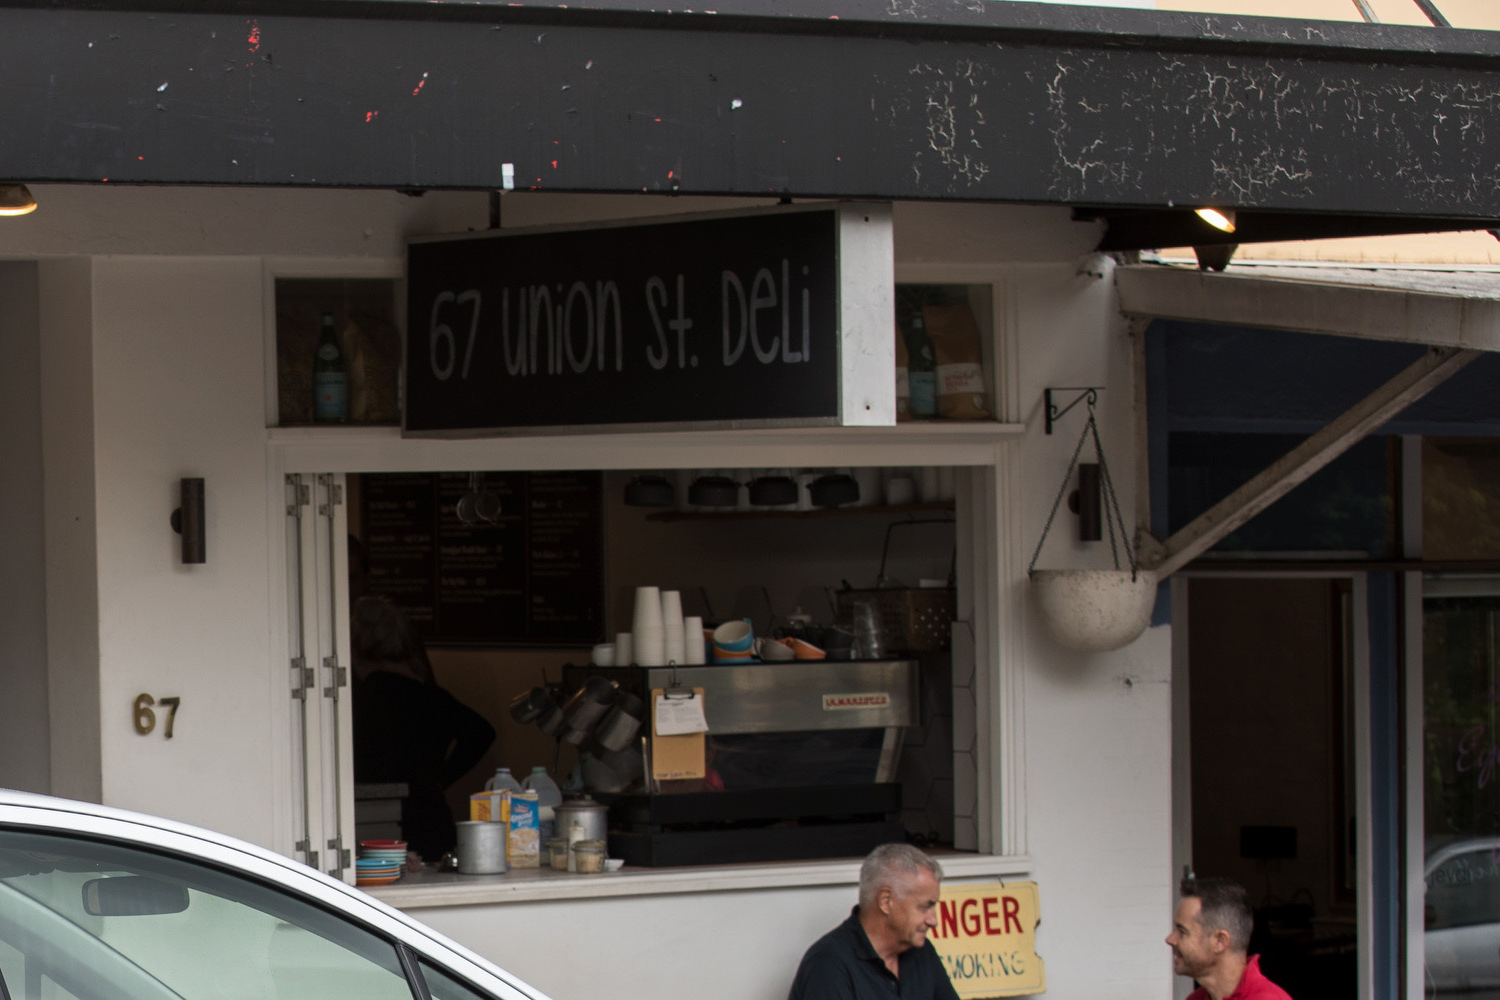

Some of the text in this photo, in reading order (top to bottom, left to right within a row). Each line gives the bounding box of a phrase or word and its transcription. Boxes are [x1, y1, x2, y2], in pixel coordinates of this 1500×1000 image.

[429, 289, 482, 381] 67
[645, 273, 699, 371] St.
[133, 692, 180, 739] 67
[929, 896, 1024, 939] NGER
